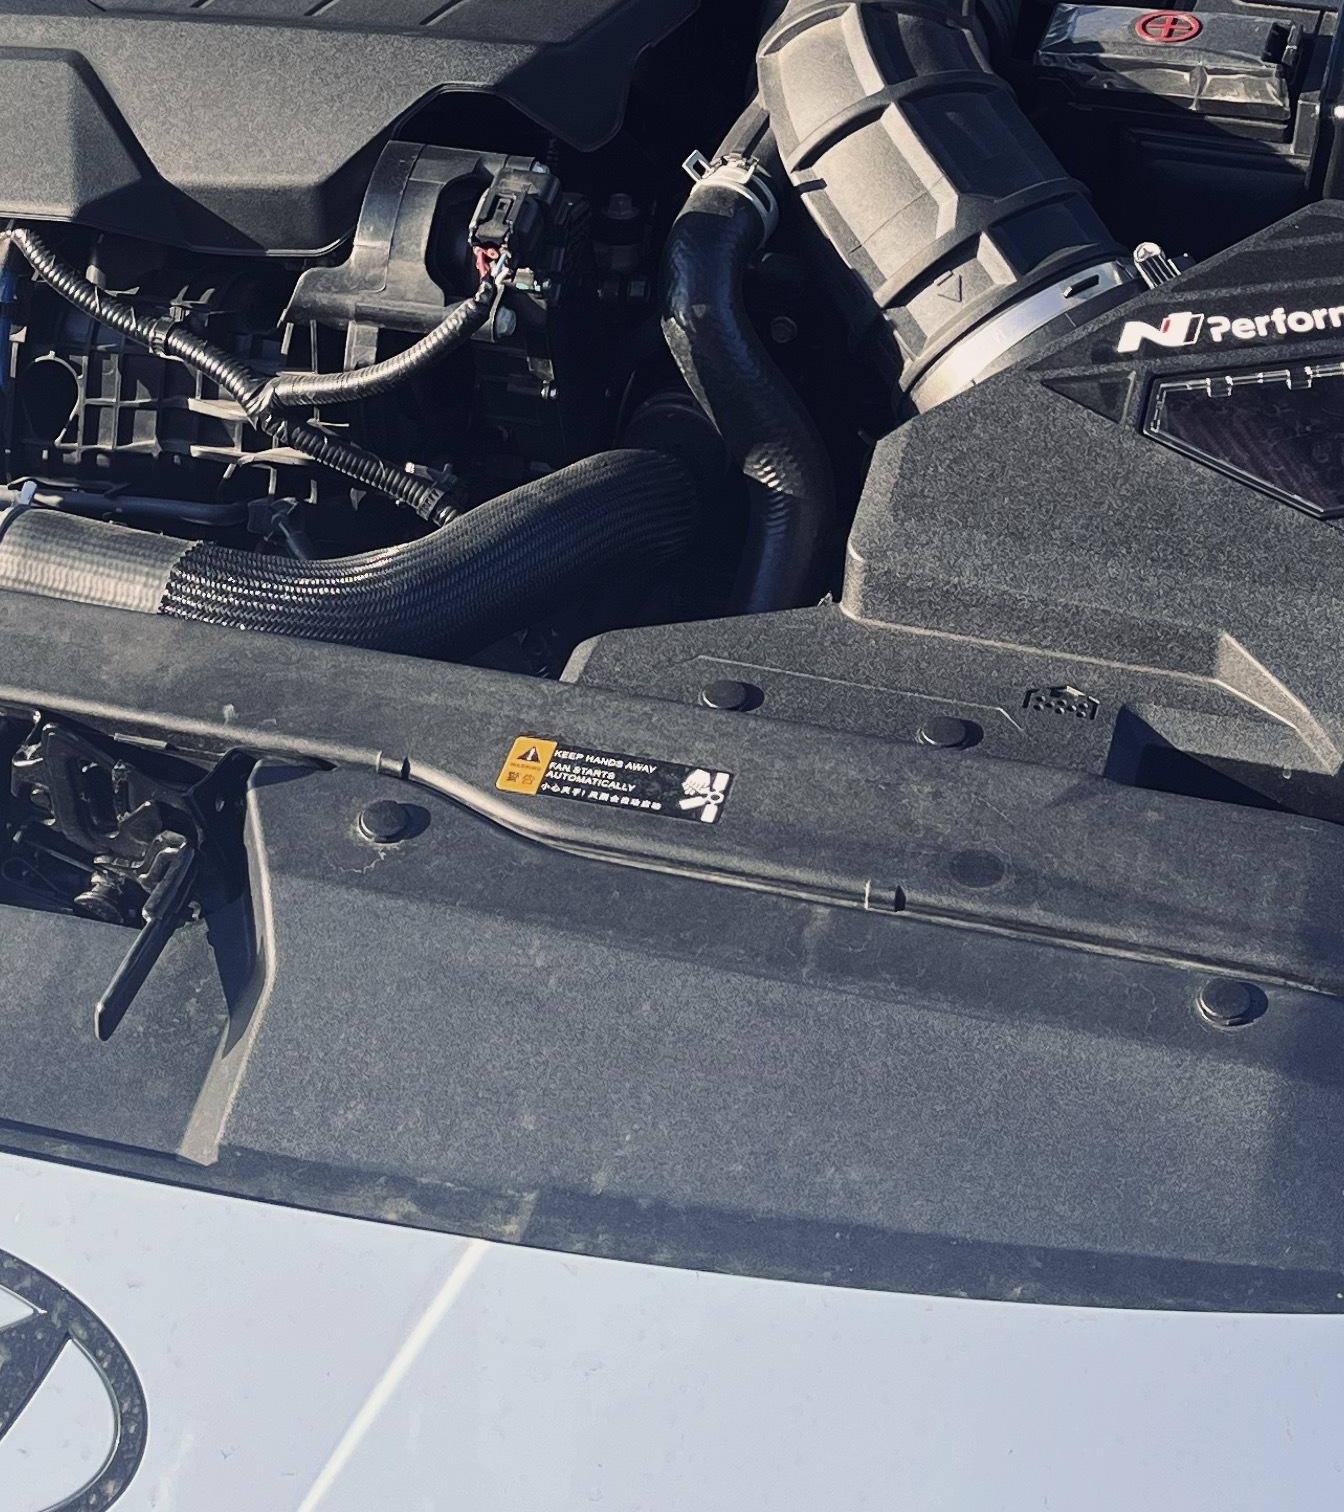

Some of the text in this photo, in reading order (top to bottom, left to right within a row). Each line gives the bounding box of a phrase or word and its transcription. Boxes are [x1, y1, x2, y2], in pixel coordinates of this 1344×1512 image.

[549, 761, 615, 780] FAN STARTS
[554, 749, 657, 774] KEEP HANDS AWAY
[545, 770, 636, 792] AUTOMATICALLY
